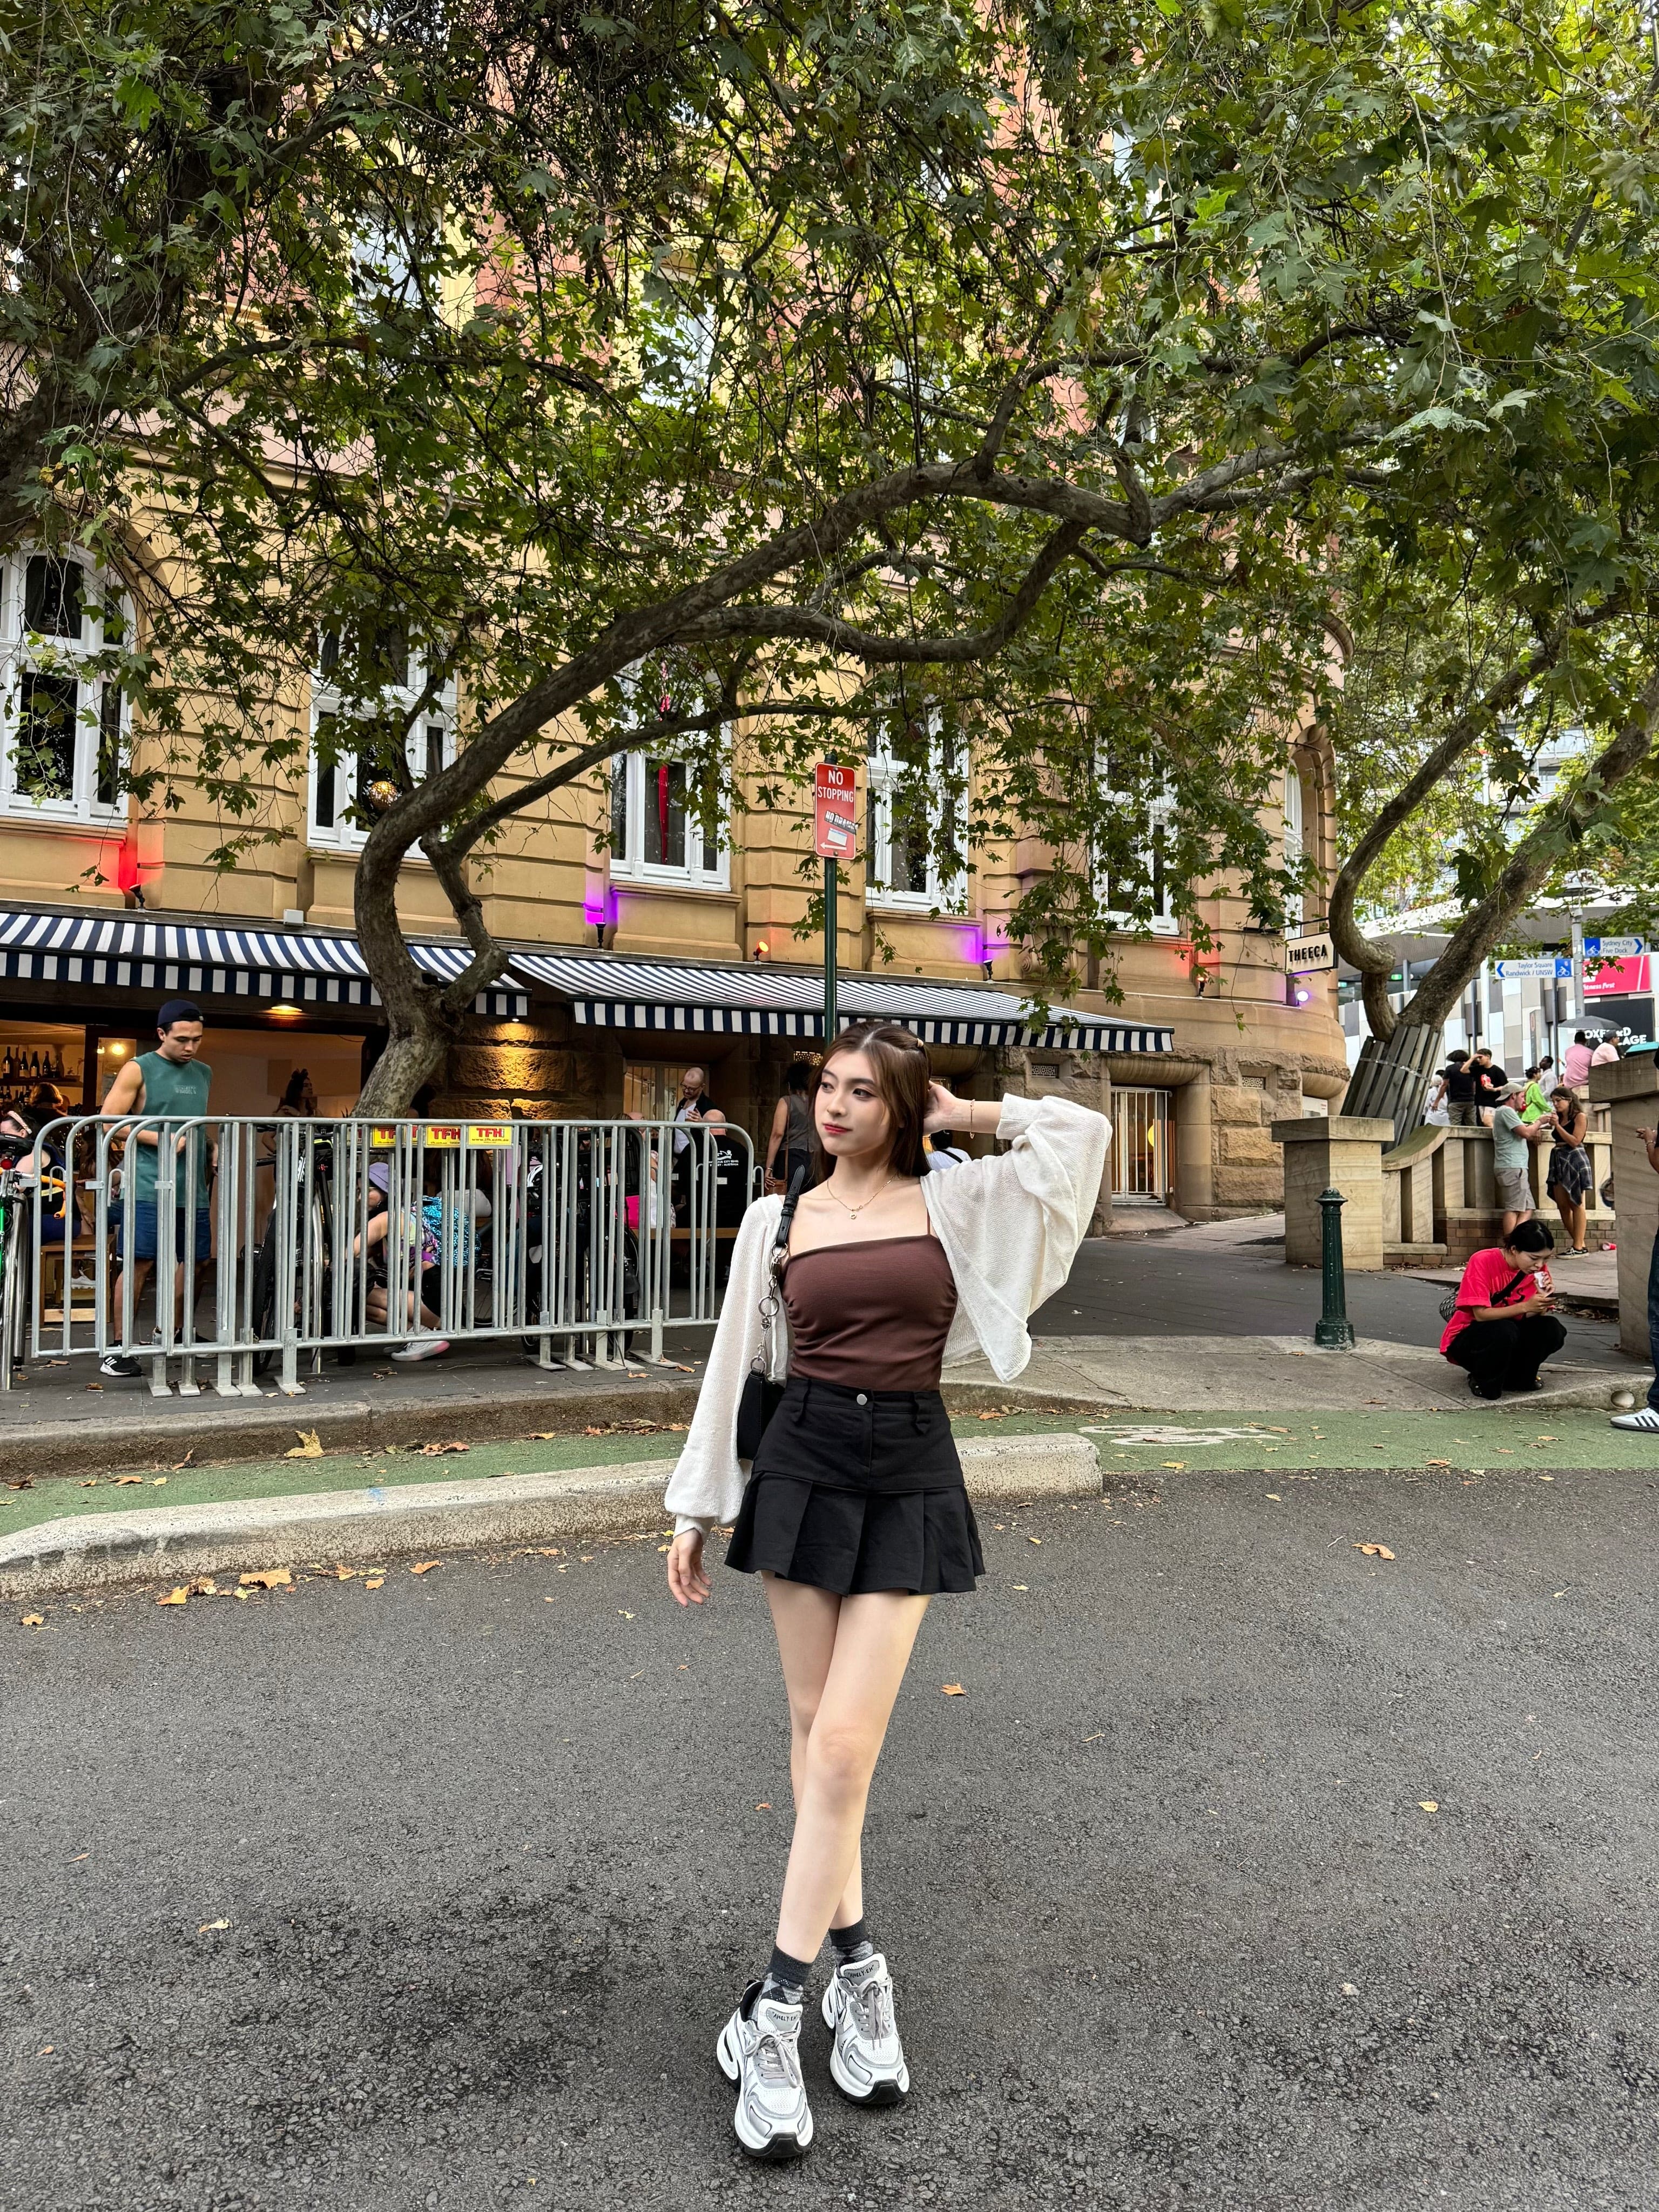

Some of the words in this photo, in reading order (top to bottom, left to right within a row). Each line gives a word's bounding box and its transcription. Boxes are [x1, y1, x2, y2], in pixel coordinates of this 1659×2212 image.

[828, 770, 844, 785] NO
[818, 786, 854, 802] STOPPING
[1288, 944, 1327, 962] THEECA
[377, 1127, 396, 1139] TF
